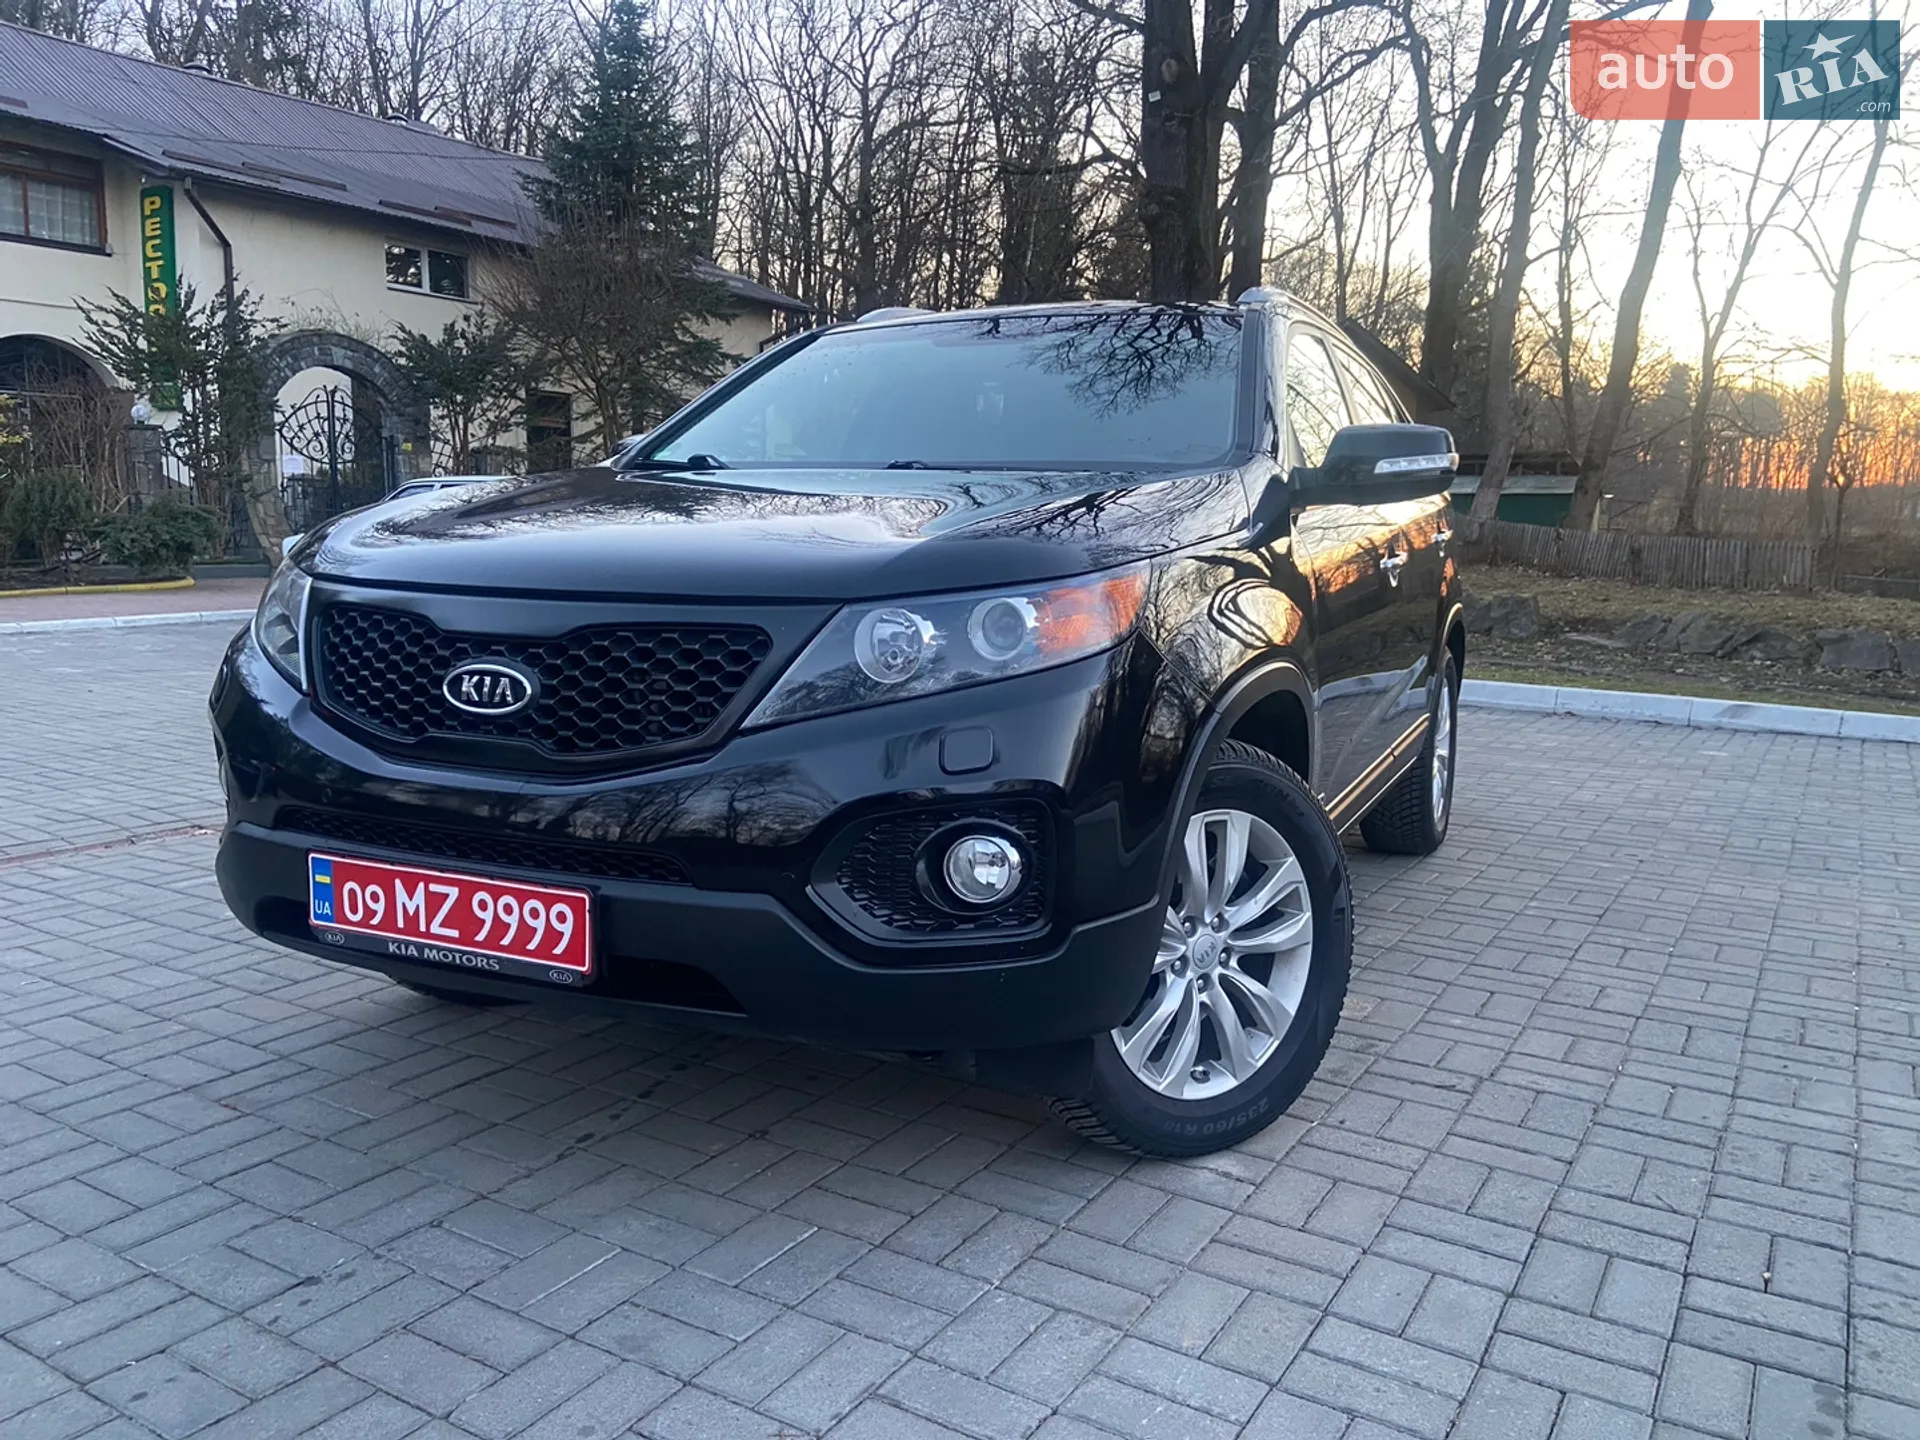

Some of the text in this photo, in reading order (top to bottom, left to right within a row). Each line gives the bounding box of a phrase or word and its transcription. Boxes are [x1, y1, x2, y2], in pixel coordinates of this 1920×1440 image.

[461, 674, 514, 704] KIA
[315, 899, 332, 916] UA
[342, 878, 574, 955] 09 MZ 9999
[388, 941, 500, 971] KIA MOTORS
[1195, 941, 1217, 964] KIA
[1203, 1096, 1269, 1135] 235/60
